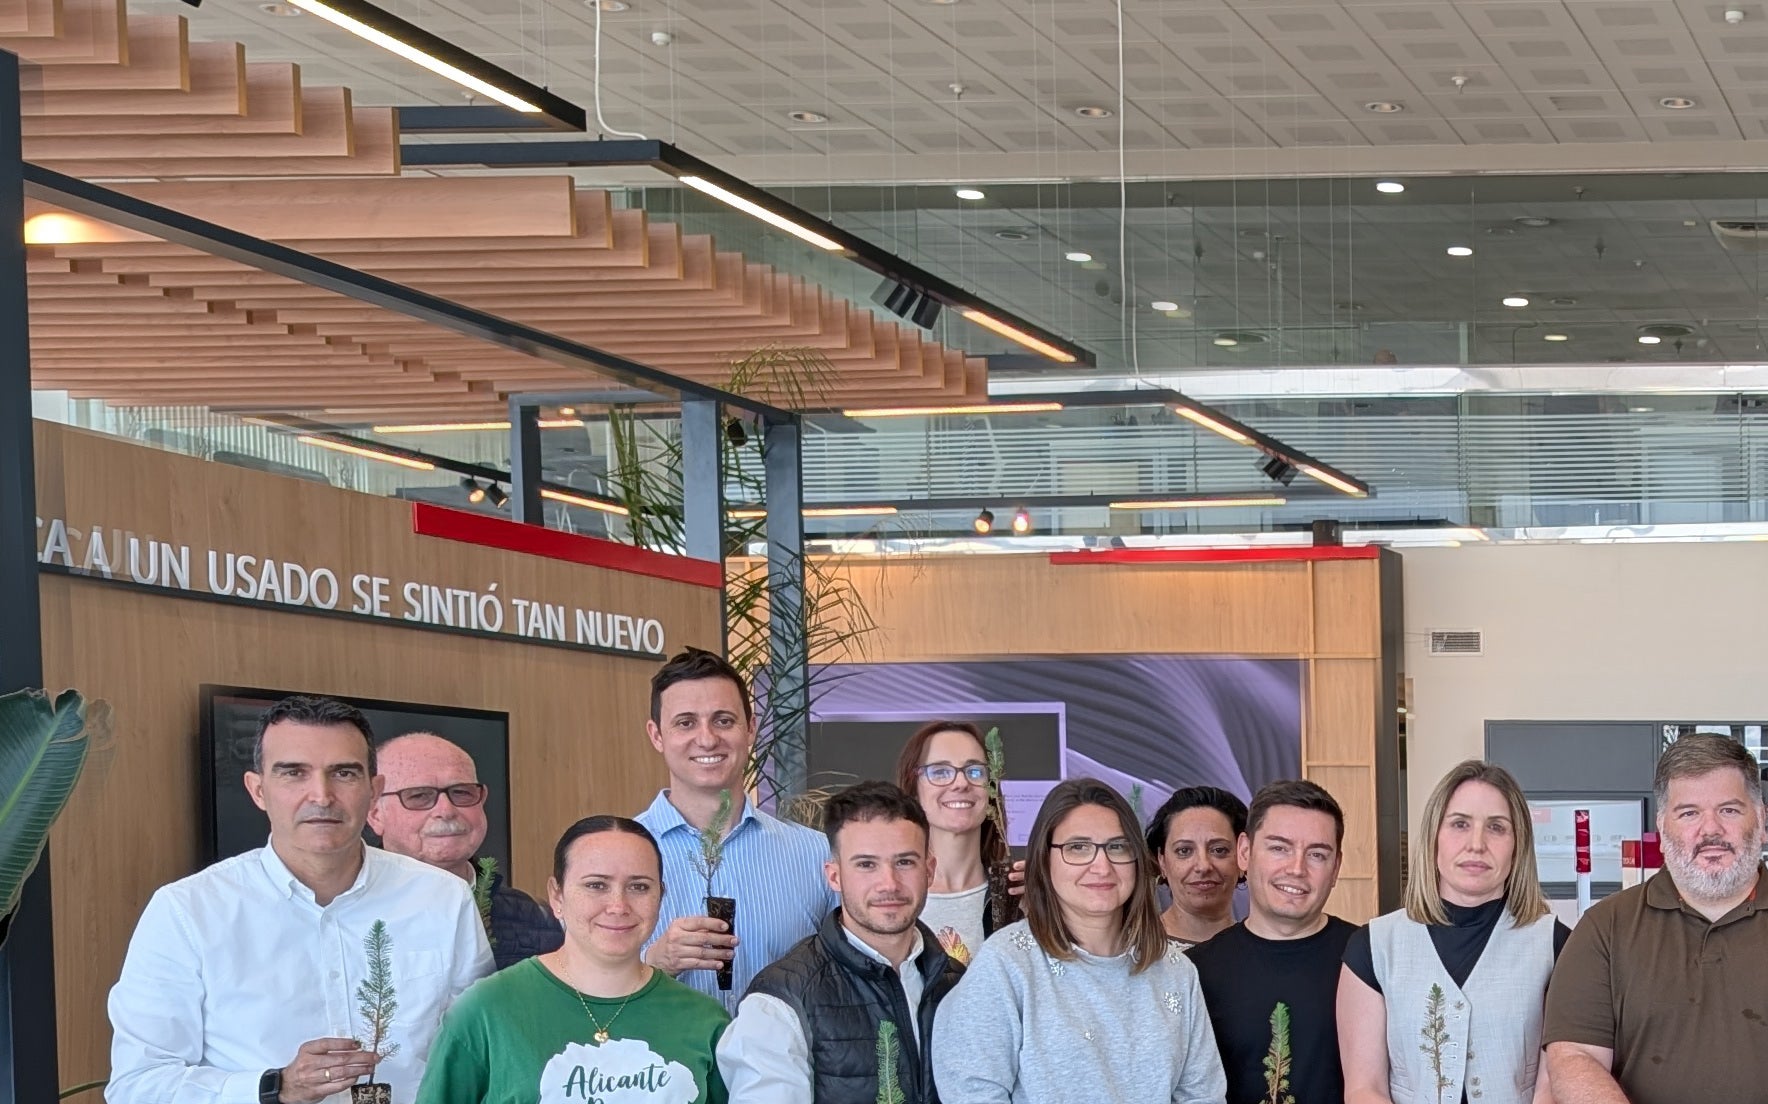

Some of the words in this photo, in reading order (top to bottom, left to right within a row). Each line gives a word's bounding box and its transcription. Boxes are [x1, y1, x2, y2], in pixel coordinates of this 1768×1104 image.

[130, 537, 190, 590] UN
[208, 550, 339, 610] USADO
[352, 574, 391, 617] SE
[403, 582, 503, 632] SINTIÓ
[512, 599, 566, 642] TAN
[576, 608, 665, 655] NUEVO
[562, 1063, 671, 1100] Alicante
